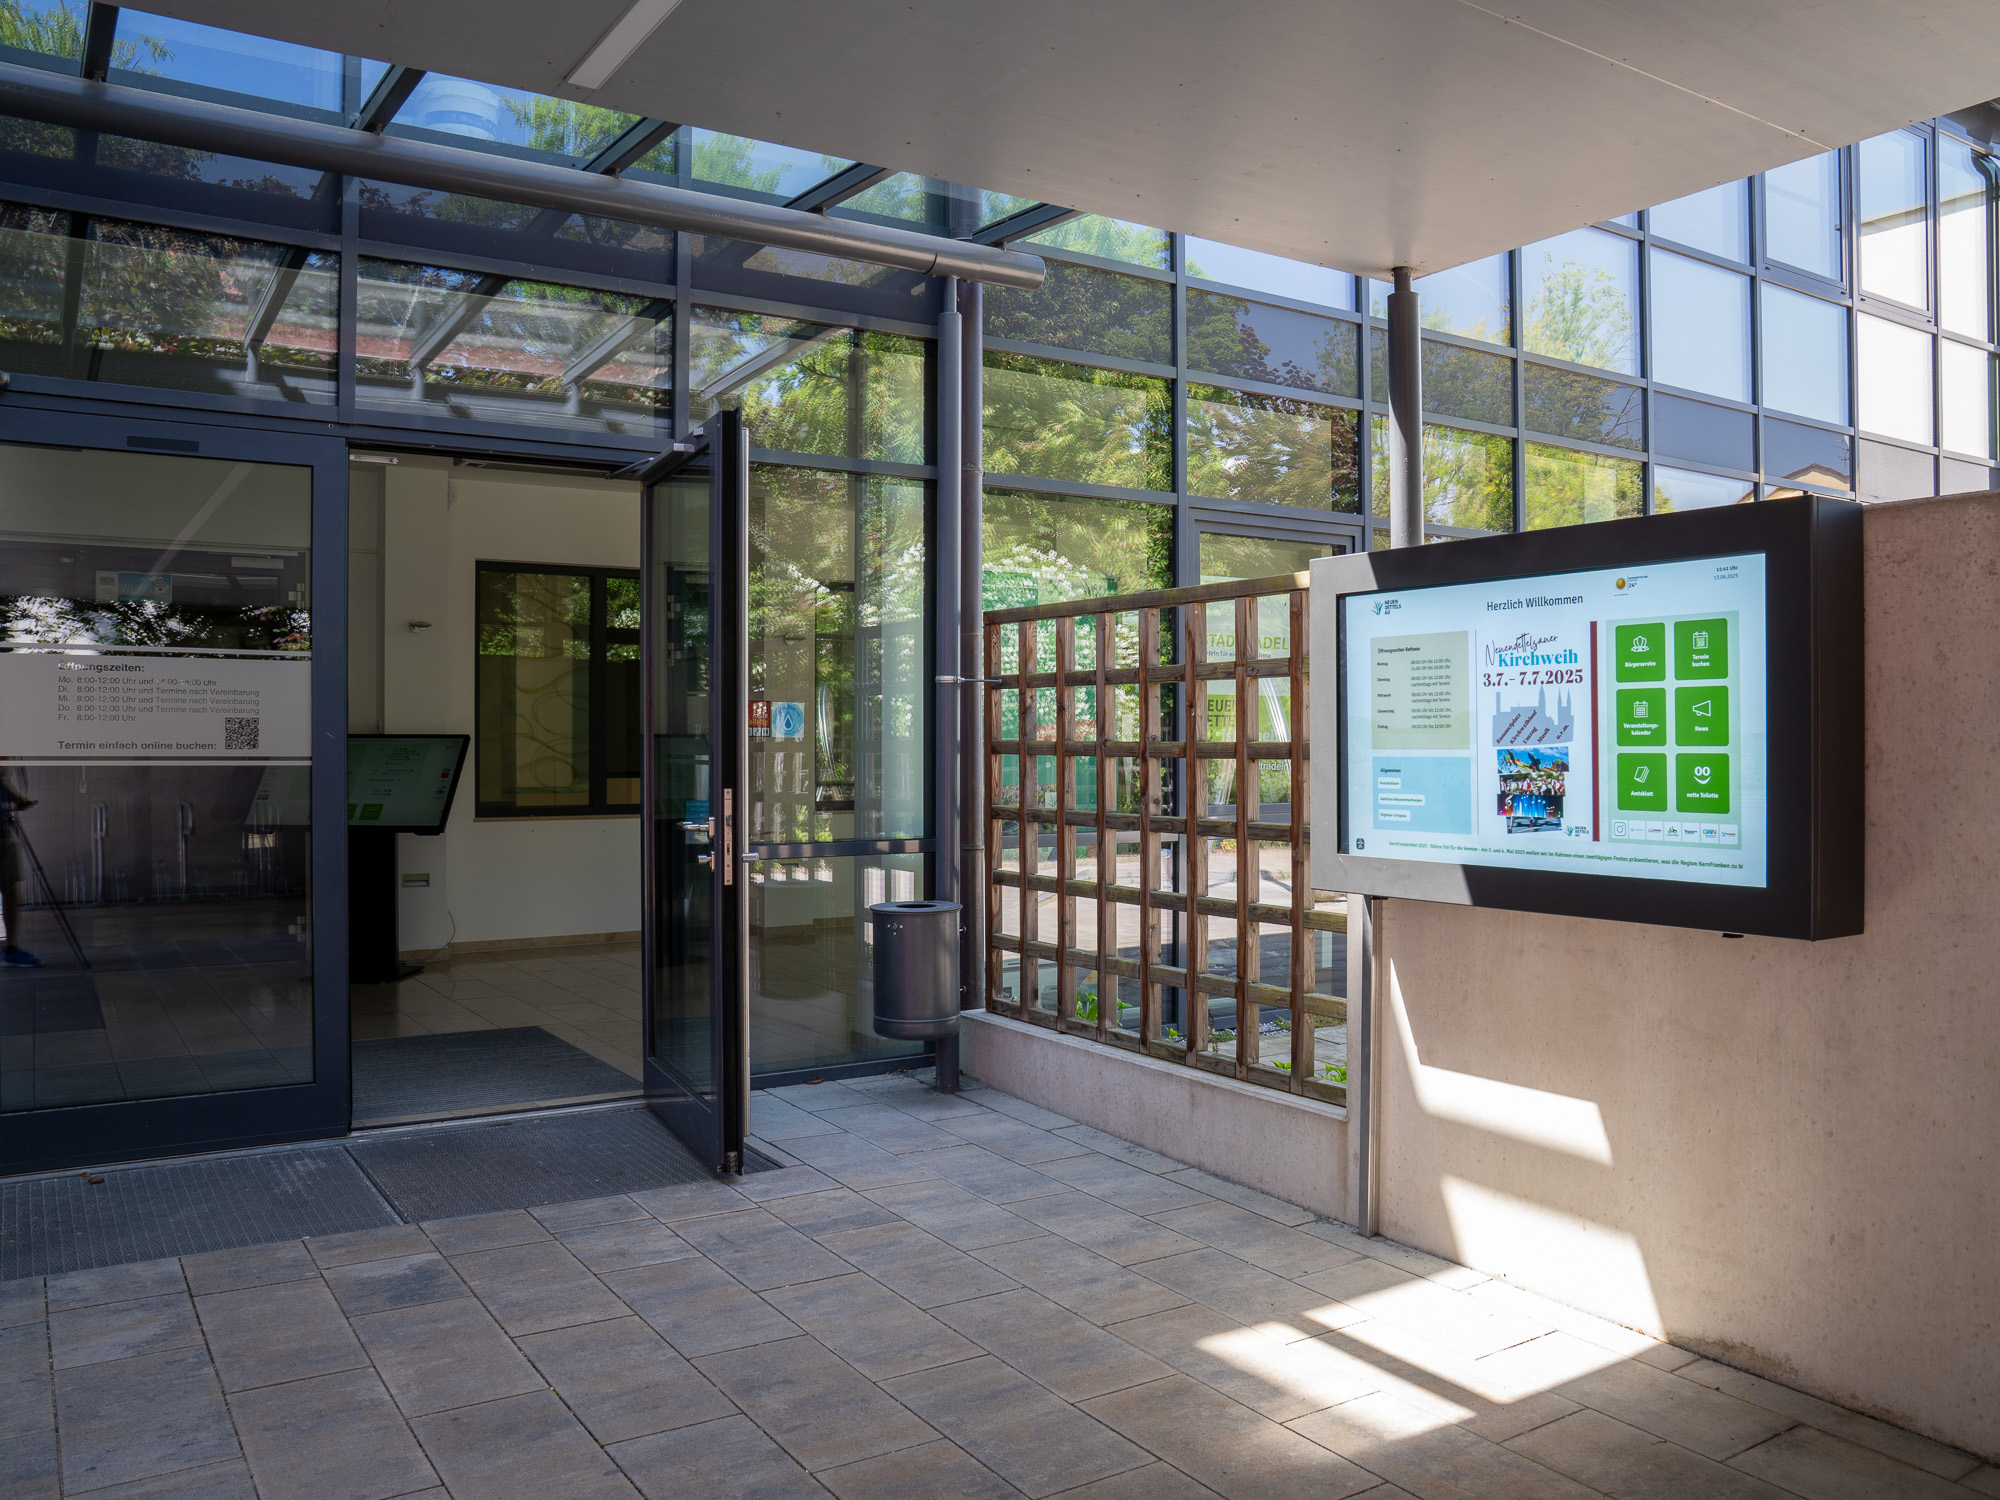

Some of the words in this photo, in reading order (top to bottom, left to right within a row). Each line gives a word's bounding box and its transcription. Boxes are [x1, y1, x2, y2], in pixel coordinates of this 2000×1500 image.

[1486, 598, 1523, 612] Herzlich
[1526, 595, 1584, 608] Willkommen
[1498, 648, 1578, 668] Kirchweih
[58, 660, 144, 673] Öffnungszeiten:
[76, 676, 120, 684] 8:00-12:00
[1520, 668, 1584, 686] 7.7.2025
[189, 688, 208, 696] nach
[210, 688, 260, 698] Vereinbarung
[210, 698, 260, 706] Vereinbarung
[210, 706, 260, 716] Vereinbarung
[1496, 712, 1521, 744] Rummelplatz
[1510, 709, 1538, 744] Kirchweihlauf
[1523, 726, 1538, 744] Umzug
[1537, 728, 1550, 743] Musik
[58, 740, 96, 750] Termin
[99, 741, 138, 750] einfach
[140, 742, 173, 750] online
[176, 742, 217, 750] buchen:
[1628, 856, 1660, 864] präsentieren,
